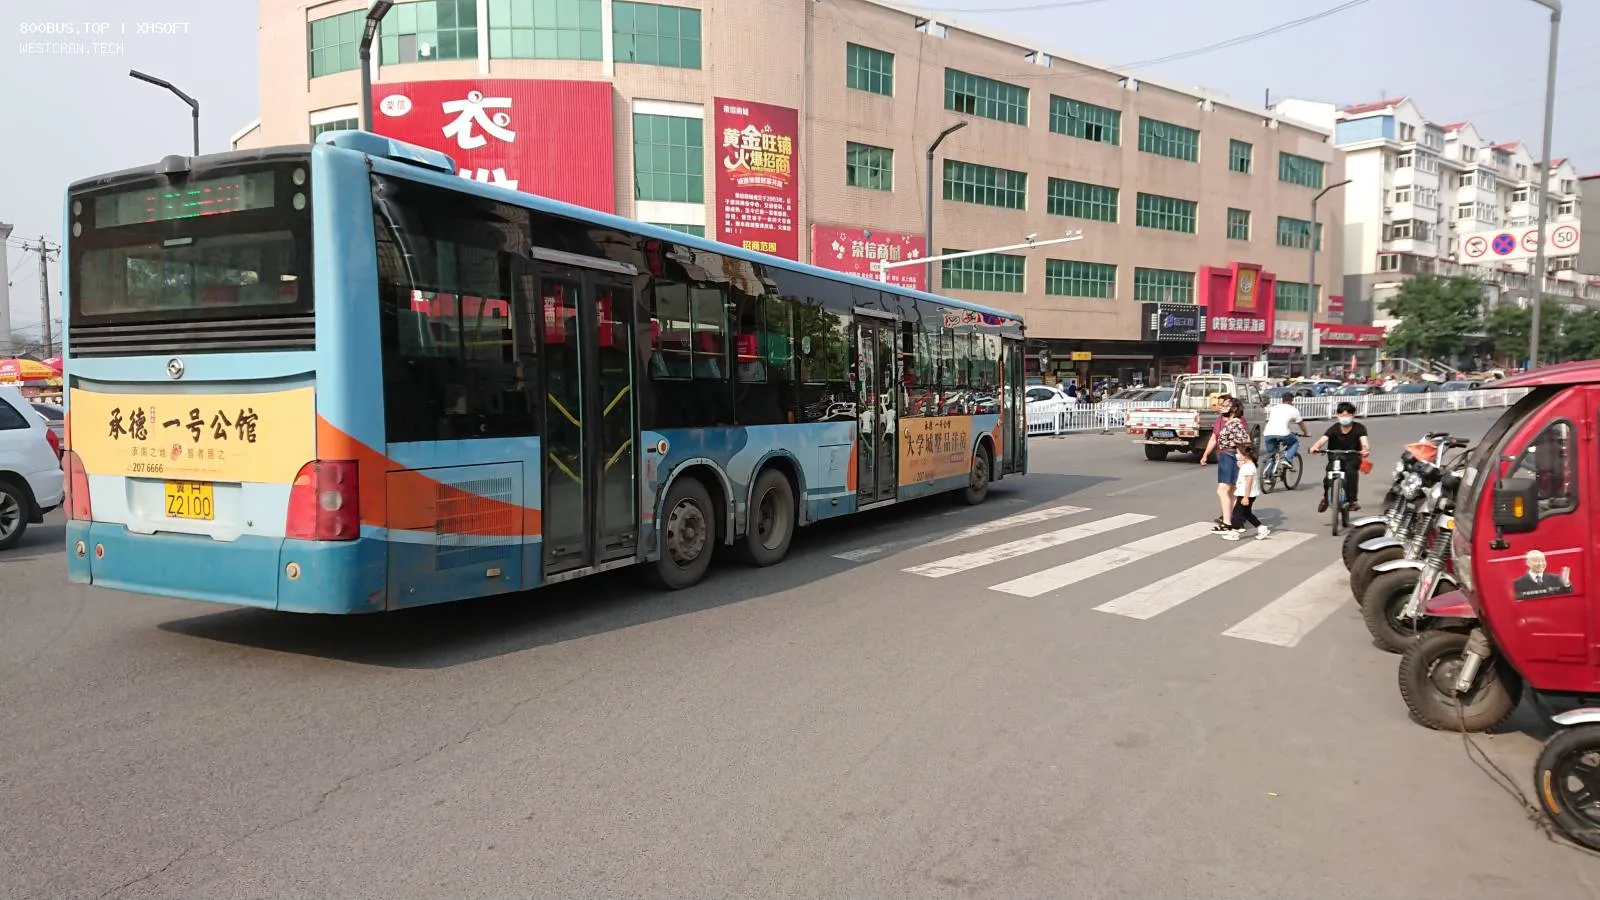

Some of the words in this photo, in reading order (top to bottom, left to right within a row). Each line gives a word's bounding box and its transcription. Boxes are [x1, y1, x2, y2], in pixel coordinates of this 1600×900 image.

[723, 124, 792, 155] 黄金旺铺
[723, 149, 791, 173] 火爆招商
[1558, 231, 1573, 243] 50
[743, 240, 777, 252] 招商范围
[132, 462, 145, 473] 207
[146, 463, 164, 473] 6666
[167, 495, 211, 517] Z2100
